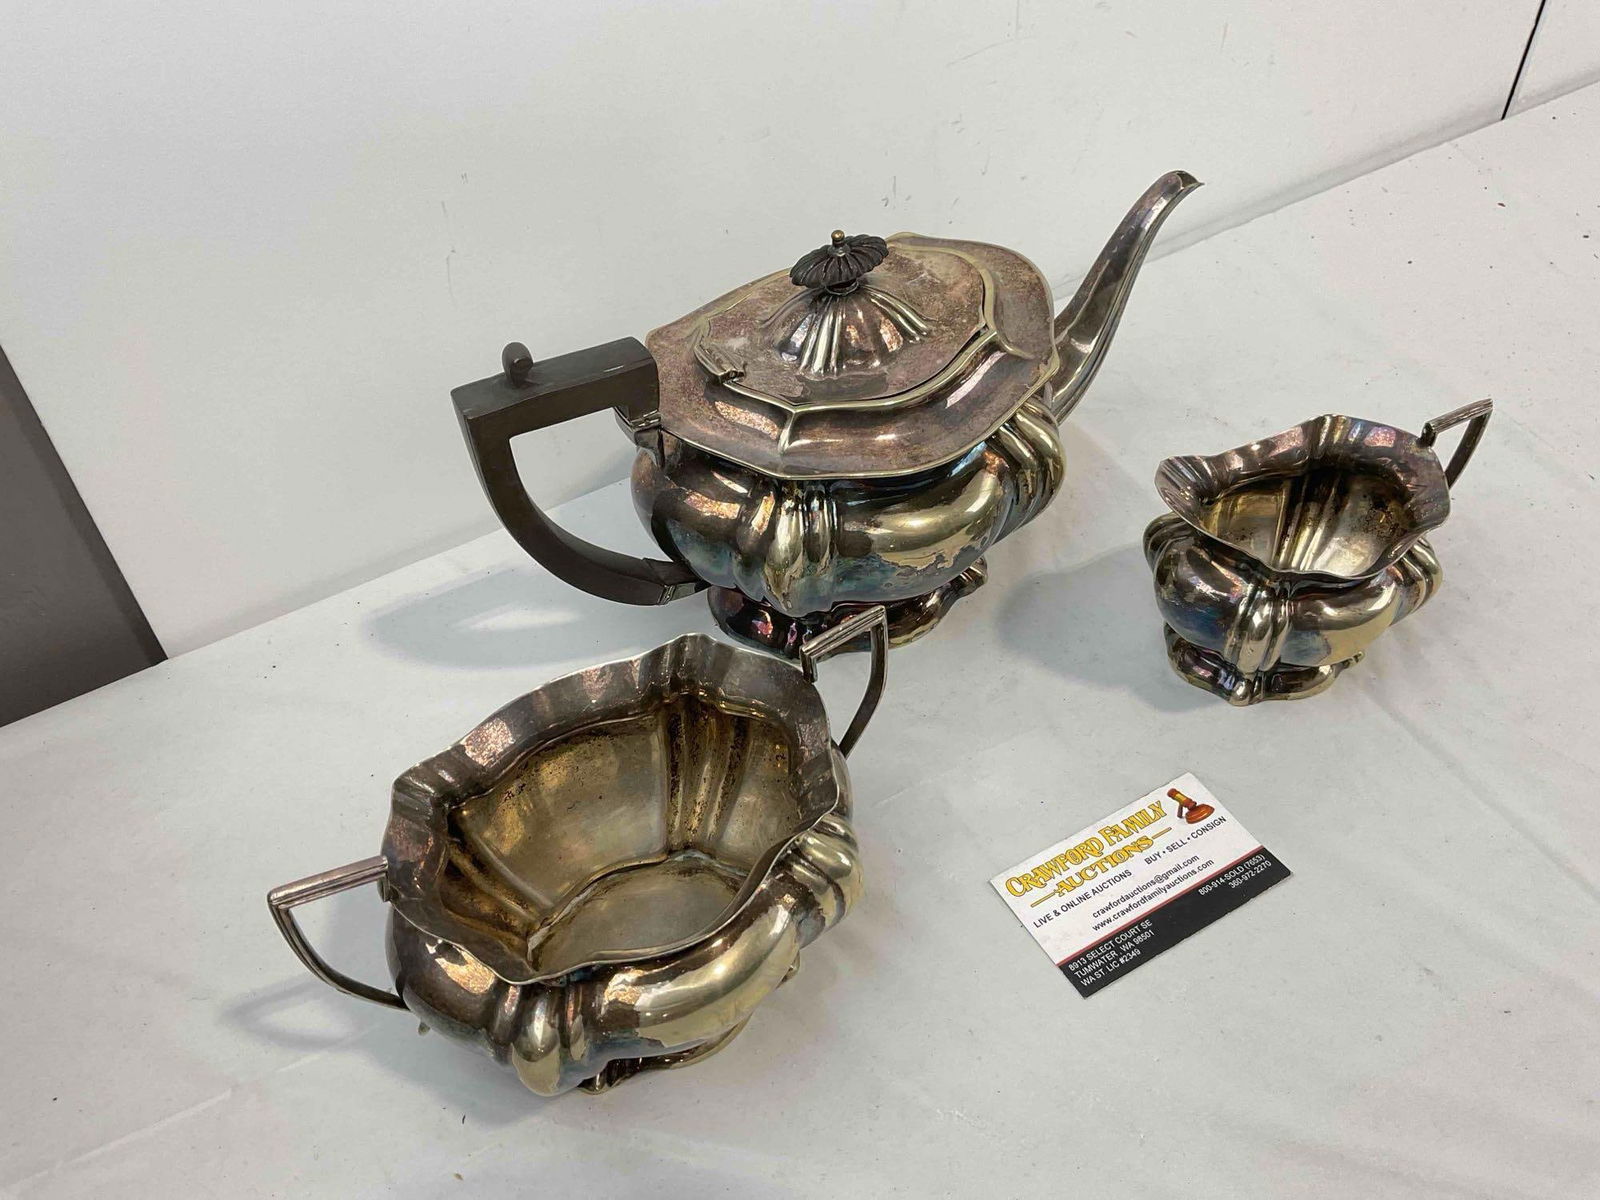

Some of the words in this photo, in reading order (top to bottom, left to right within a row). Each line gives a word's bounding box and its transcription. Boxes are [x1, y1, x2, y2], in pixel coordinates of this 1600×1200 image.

[1005, 836, 1104, 897] CRAWFORD
[1098, 800, 1167, 846] FAMILY
[1054, 835, 1153, 897] AUCTIONS
[1144, 851, 1162, 865] BUY
[1166, 839, 1188, 853] SELL
[1190, 816, 1226, 839] CONSIGN
[1033, 912, 1053, 928] LIVE
[1054, 909, 1061, 917] &
[1061, 892, 1092, 913] ONLINE
[1091, 869, 1132, 897] AUCTIONS
[1092, 854, 1200, 919] crawfordauctions@gmail.com
[1092, 859, 1214, 931] www.crawfordfamilyauctions.com
[1198, 865, 1244, 895] 800-914-SOLD
[1244, 854, 1266, 870] (7653)
[1228, 860, 1272, 888] 360-972-2270
[1068, 957, 1087, 971] 8913
[1086, 940, 1115, 961] SELECT
[1114, 926, 1141, 944] COURT
[1141, 919, 1153, 929] SE
[1074, 950, 1118, 979] TUMWATER
[1120, 941, 1135, 952] WA
[1133, 929, 1155, 945] 98501
[1080, 975, 1096, 987] WA
[1106, 960, 1120, 972] LIC
[1119, 948, 1141, 965] #2349
